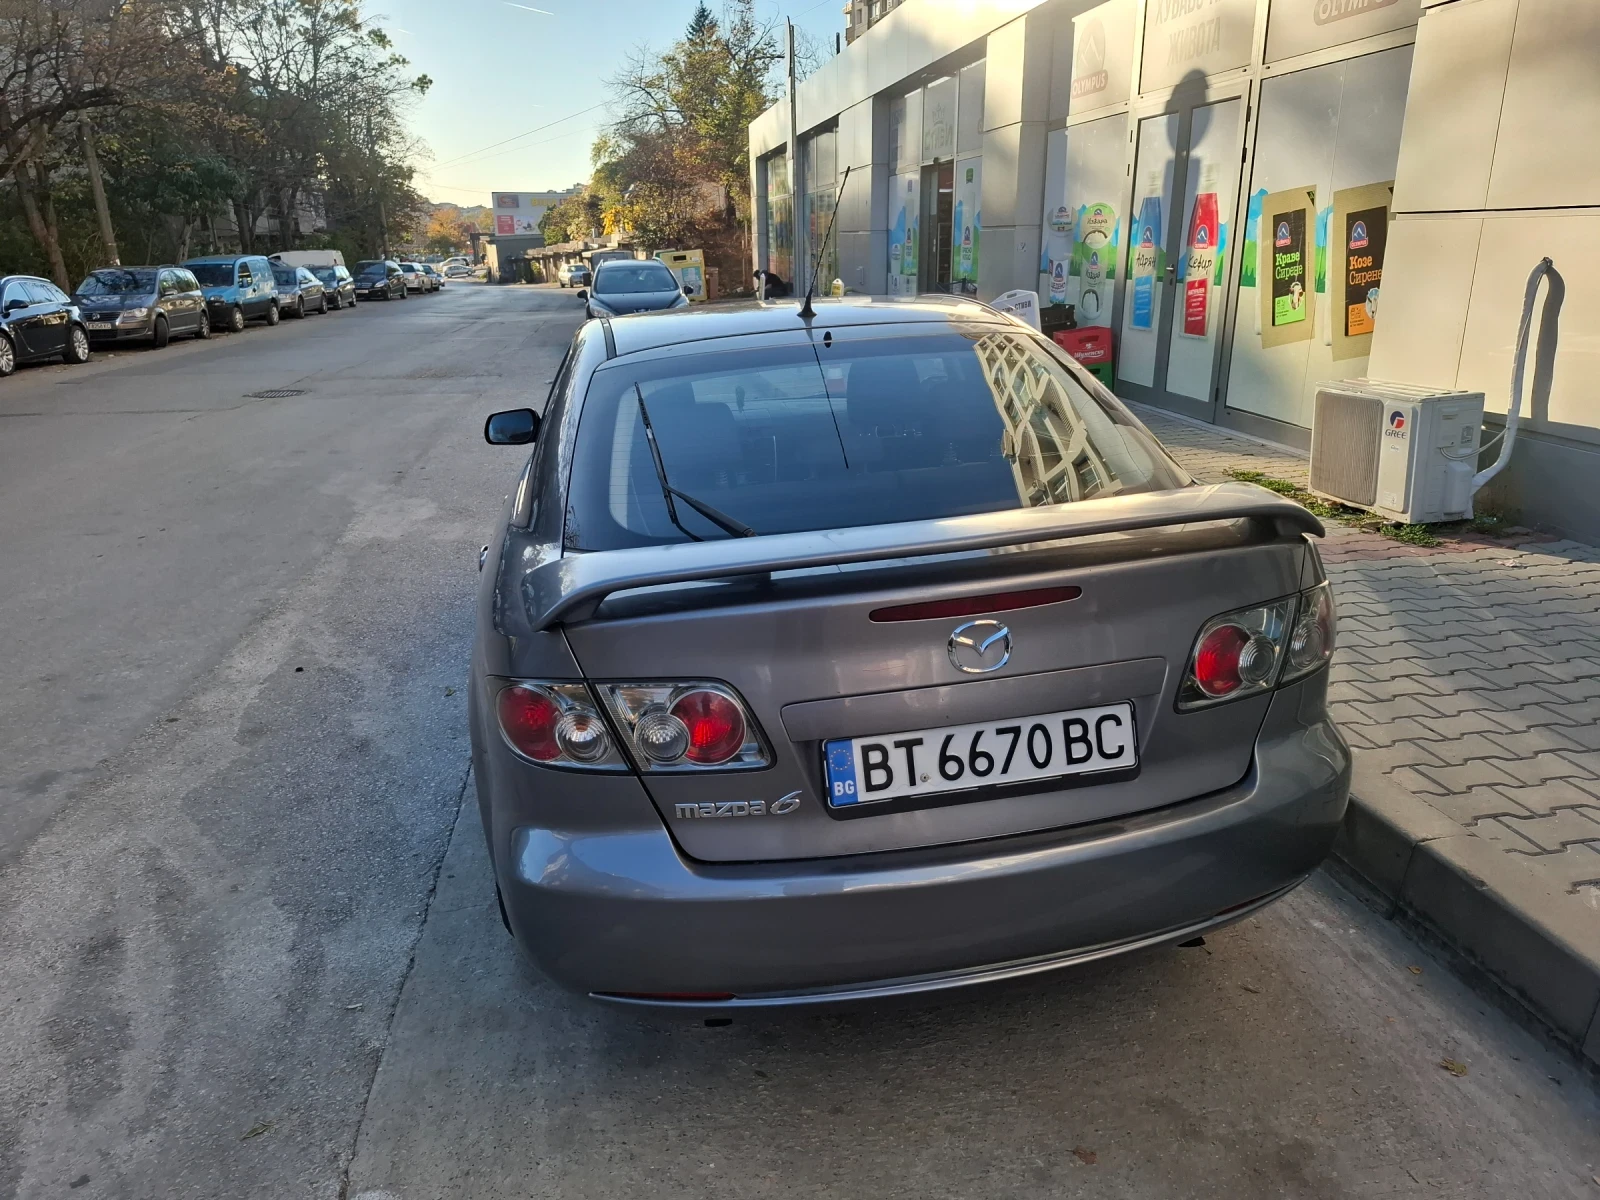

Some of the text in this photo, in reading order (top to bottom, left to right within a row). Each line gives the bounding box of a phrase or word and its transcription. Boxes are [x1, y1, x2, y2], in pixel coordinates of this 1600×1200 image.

[1167, 16, 1221, 66] ЖИВОТА
[1073, 73, 1106, 96] OLYMPUS
[1187, 254, 1213, 275] Кефир
[1275, 251, 1300, 266] Краве
[1349, 256, 1373, 270] Козе
[1275, 264, 1303, 280] Сирене
[1349, 269, 1382, 285] Сирене
[1385, 429, 1407, 440] GREE
[860, 713, 1126, 793] BT 6670 BC
[834, 780, 855, 797] BG
[769, 790, 803, 815] 6
